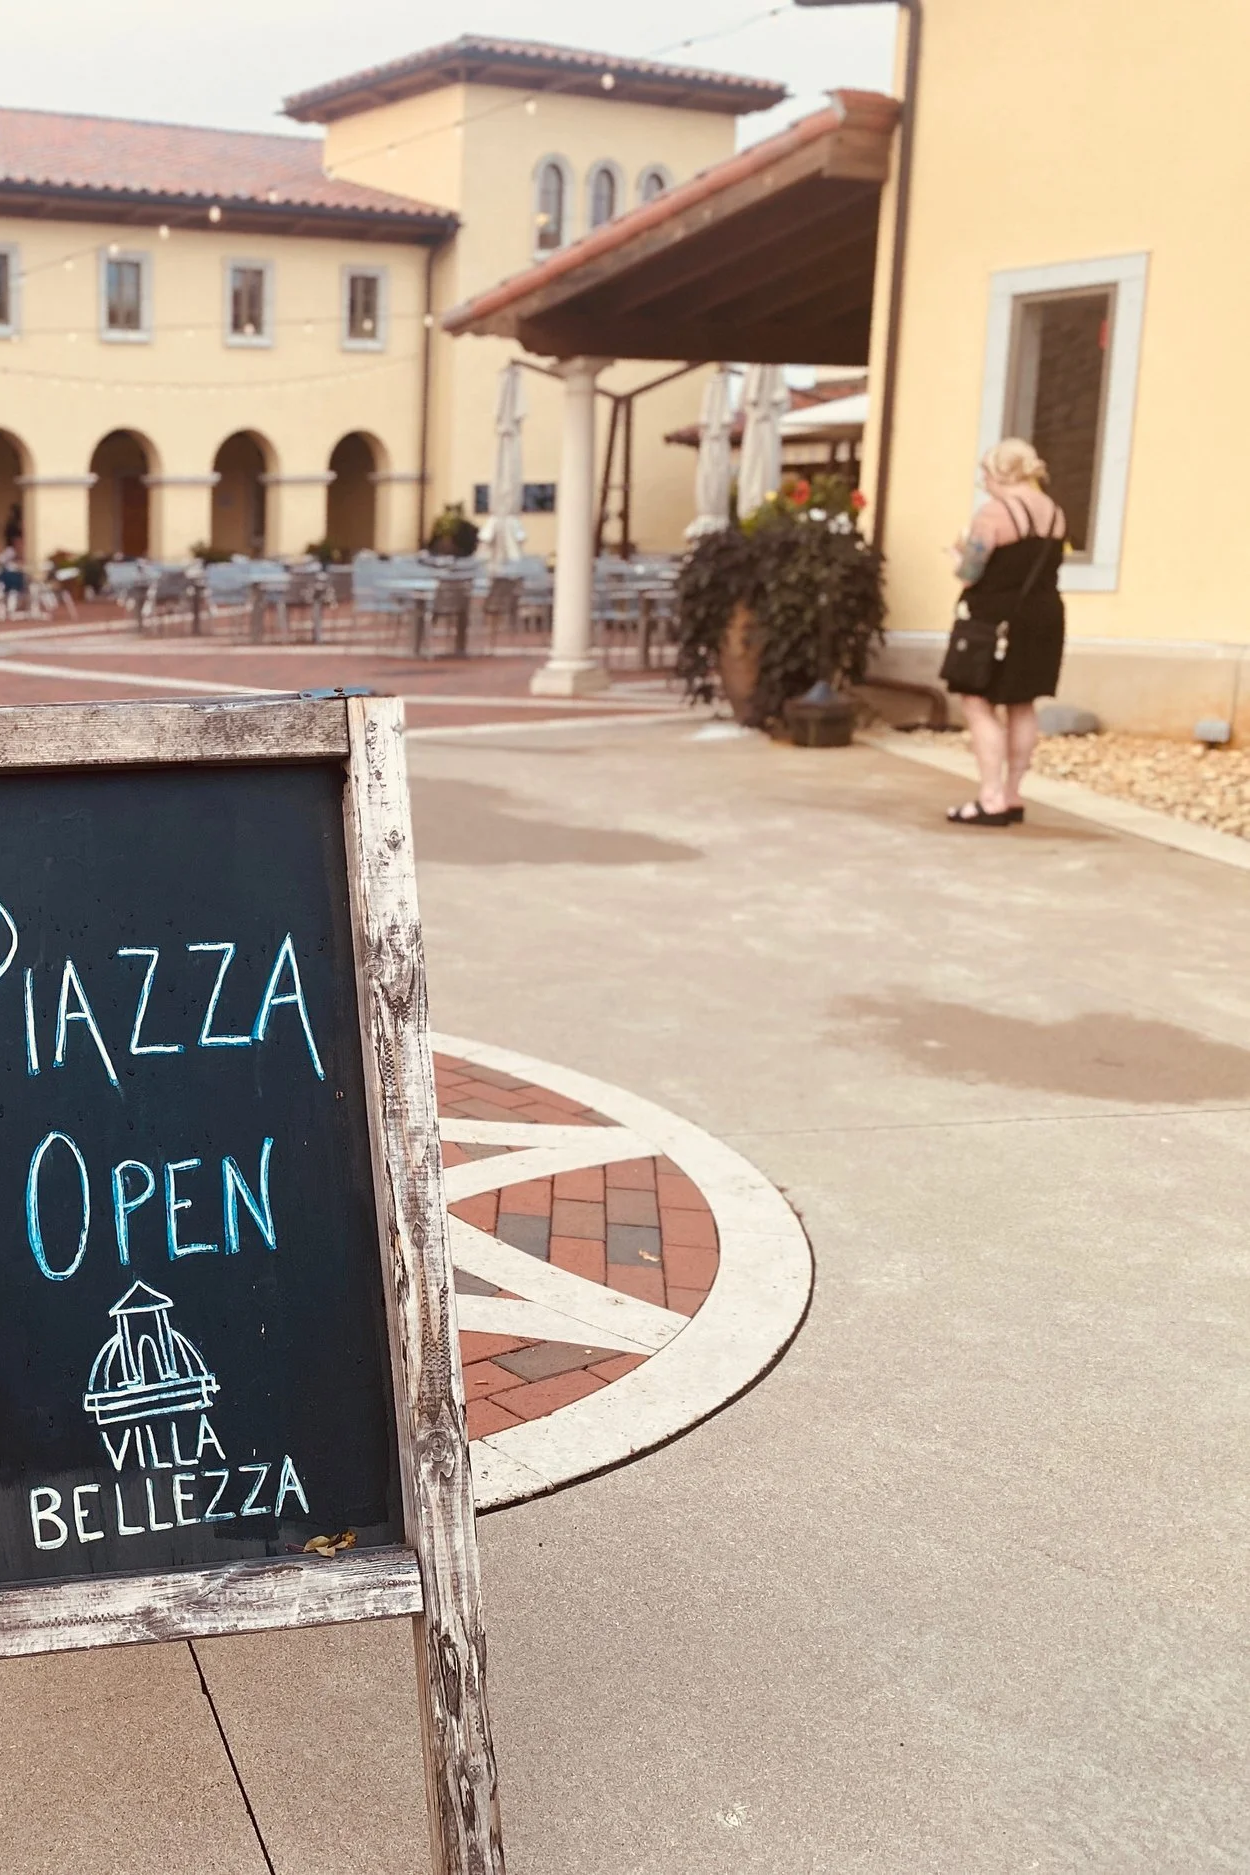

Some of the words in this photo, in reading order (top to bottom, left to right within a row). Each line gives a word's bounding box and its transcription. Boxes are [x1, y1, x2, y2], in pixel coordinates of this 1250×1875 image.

[26, 1131, 277, 1281] OPEN
[100, 1414, 226, 1472] VILLA
[29, 1455, 310, 1551] BELLEZZA
